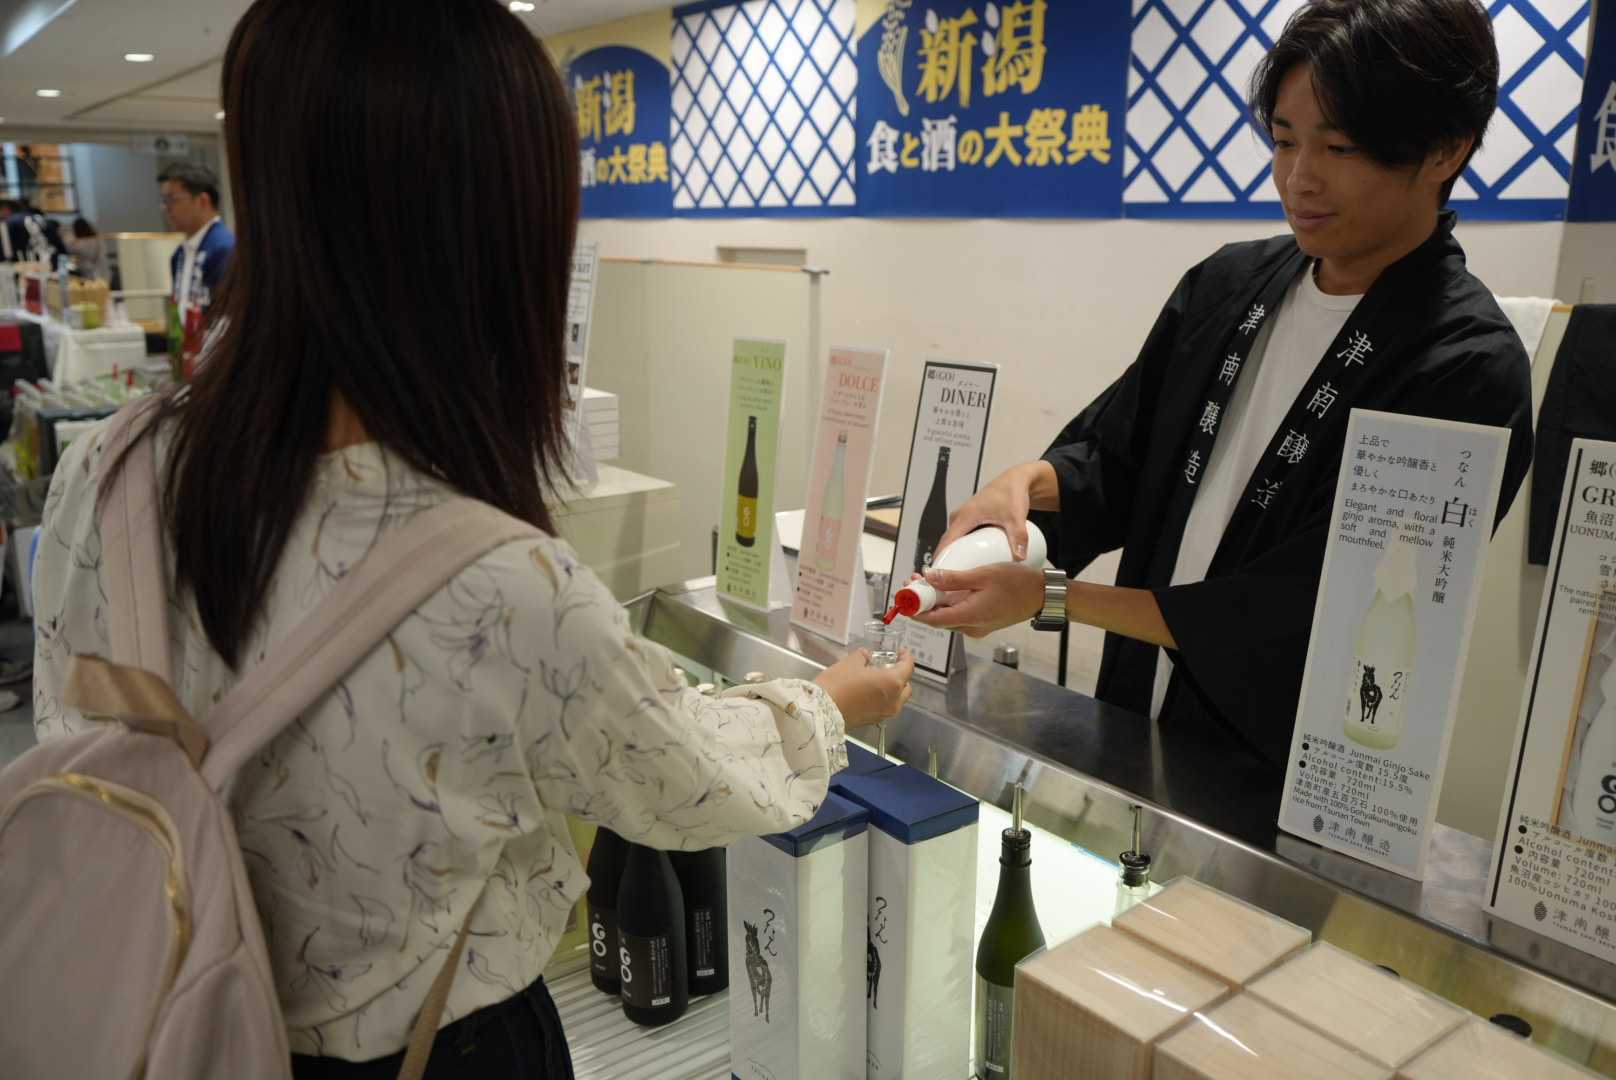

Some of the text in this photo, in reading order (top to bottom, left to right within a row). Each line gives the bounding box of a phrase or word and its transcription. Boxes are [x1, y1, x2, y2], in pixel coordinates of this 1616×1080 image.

[917, 0, 1047, 108] 新潟
[866, 105, 1112, 175] 食と酒の大祭典
[839, 371, 881, 393] DOLCE
[939, 387, 988, 409] DINER
[1359, 434, 1390, 449] 上品で
[1353, 464, 1379, 480] 優しく
[1356, 449, 1438, 472] 華やかな吟醸香と
[1453, 449, 1473, 488] つなん
[1351, 481, 1436, 505] まろやかな口あたり
[1342, 510, 1437, 536] ginjo aroma, with a
[1344, 498, 1439, 524] Elegant and floral
[1440, 496, 1469, 528] 白
[1468, 507, 1478, 528] はく
[1584, 510, 1616, 528] 魚沼
[1338, 533, 1386, 551] mouthfeel.
[1340, 521, 1434, 548] soft and mellow
[1431, 536, 1456, 604] 純米大吟醸
[1559, 584, 1575, 596] The
[1302, 752, 1338, 769] Alcohol
[1350, 749, 1382, 765] Junmai
[1383, 759, 1407, 774] Ginjo
[1408, 767, 1431, 781] Sake
[1299, 770, 1370, 800] Volume: 720ml
[1310, 764, 1376, 793] 内容量 720ml
[1294, 786, 1312, 799] Made
[1313, 791, 1329, 803] with
[1329, 796, 1349, 812] 100%
[1305, 798, 1323, 811] from
[1323, 804, 1349, 821] Tsunan
[1350, 814, 1370, 828] Town
[1518, 836, 1562, 858] Alcohol
[1515, 855, 1602, 895] Volume: 720ml
[1528, 850, 1610, 887] 内容量 720ml
